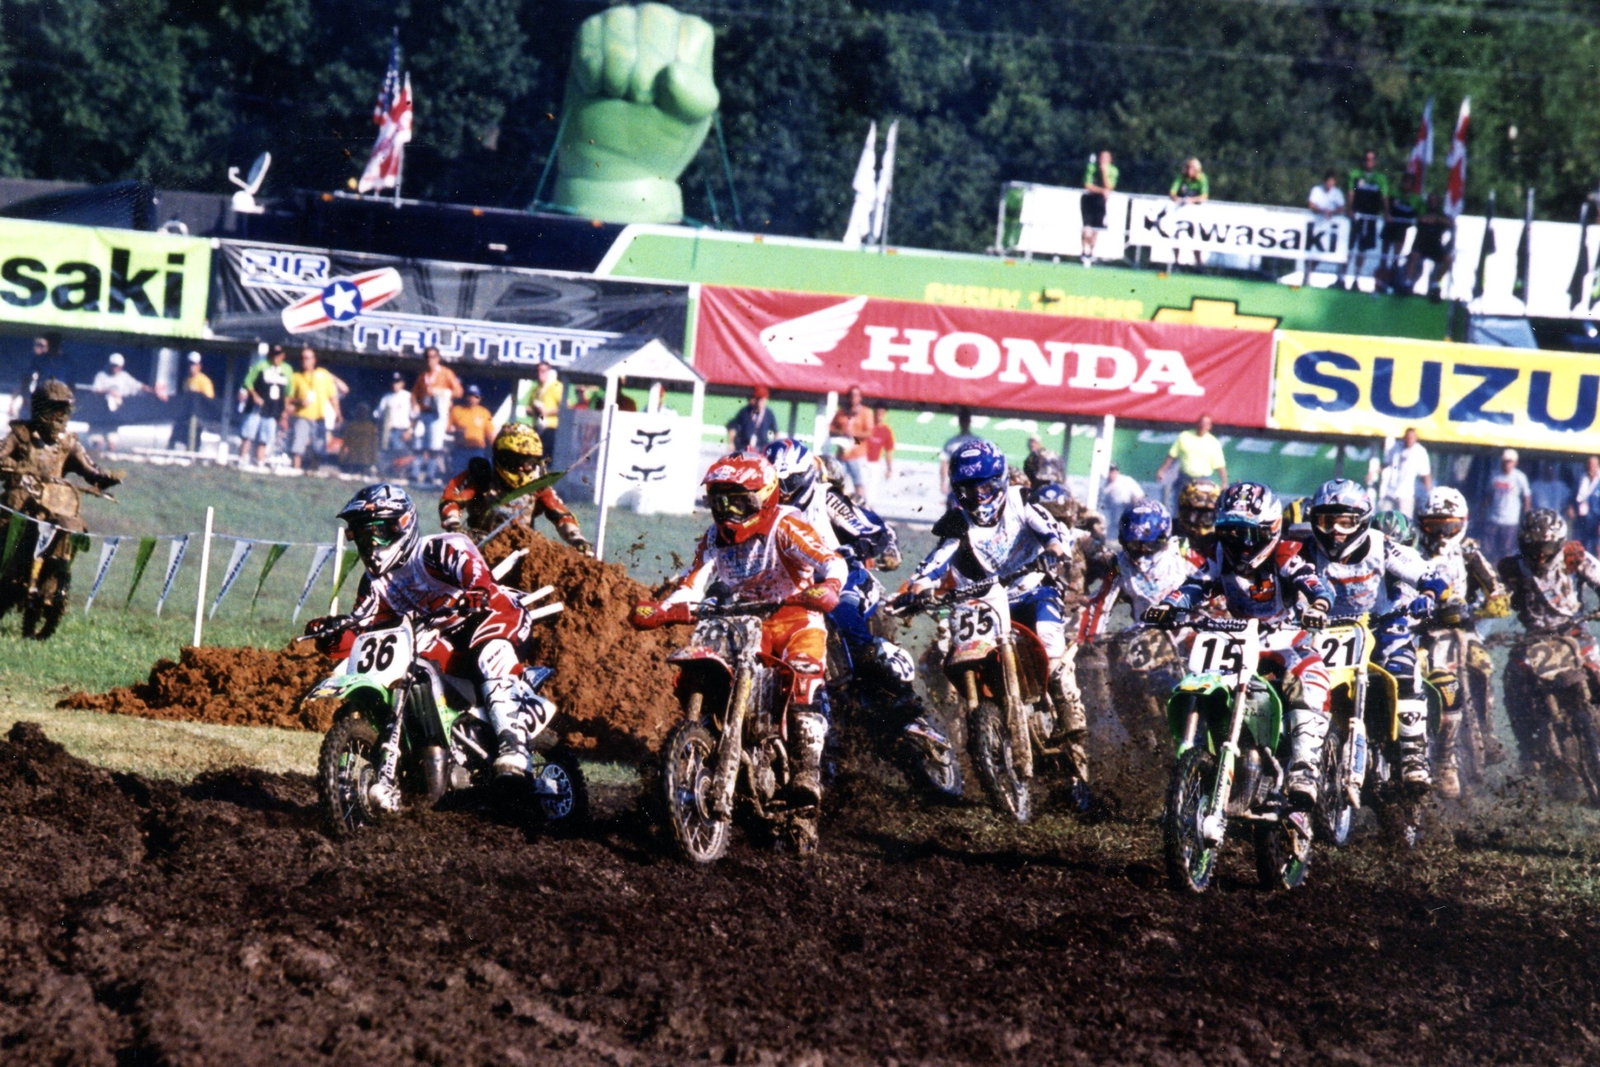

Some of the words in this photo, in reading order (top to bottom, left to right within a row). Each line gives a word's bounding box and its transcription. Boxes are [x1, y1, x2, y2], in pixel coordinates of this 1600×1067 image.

[1144, 203, 1340, 254] Kawasaki
[0, 247, 185, 320] saki
[860, 325, 1205, 397] HONDA
[1292, 350, 1600, 433] SUZU
[959, 607, 993, 641] 55
[357, 634, 398, 674] 36
[1202, 638, 1246, 674] 15
[1322, 637, 1356, 668] 21
